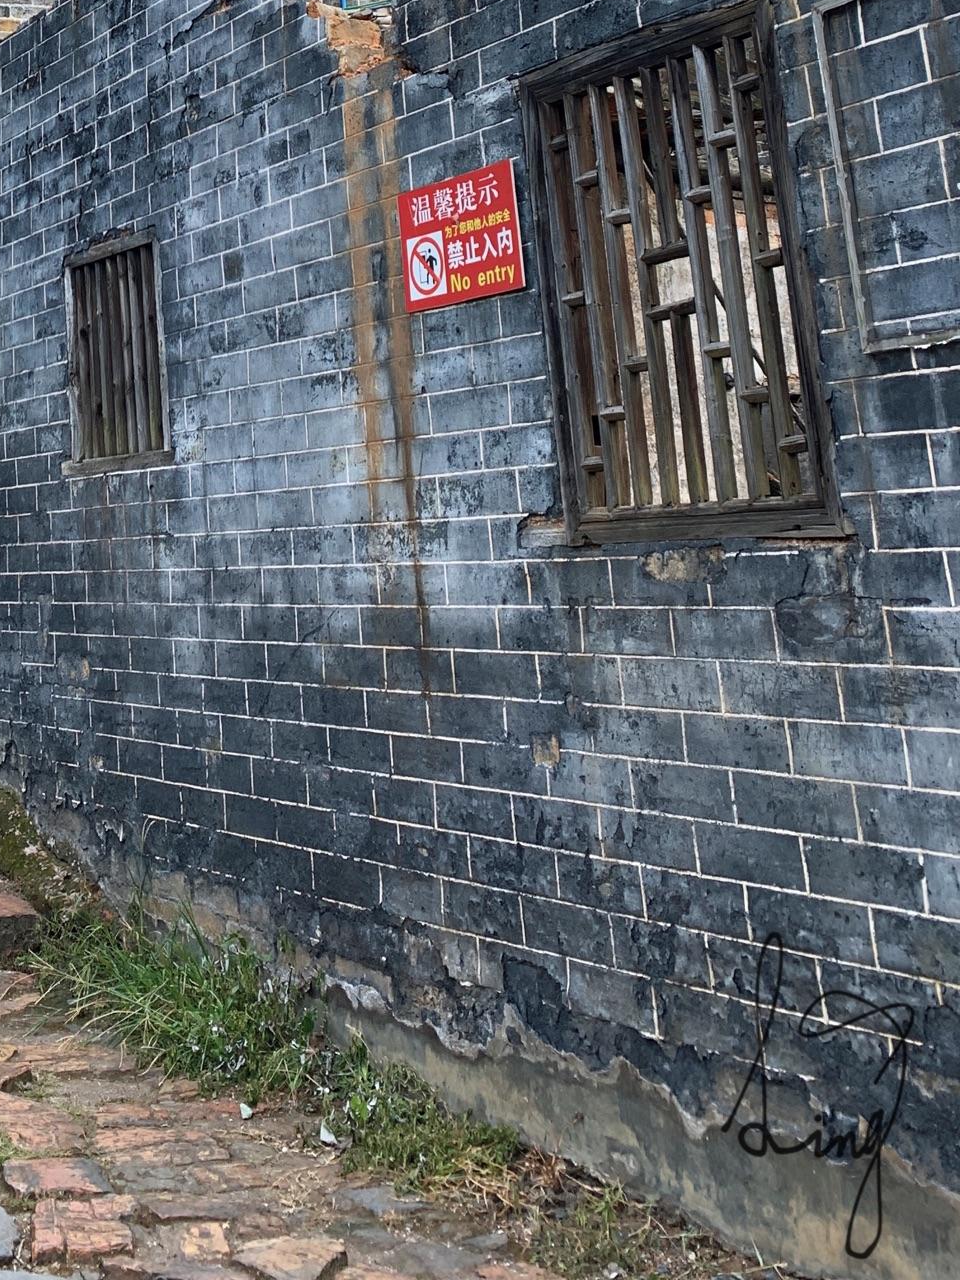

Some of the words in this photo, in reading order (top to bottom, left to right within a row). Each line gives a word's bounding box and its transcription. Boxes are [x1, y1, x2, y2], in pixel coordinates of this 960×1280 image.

[411, 173, 498, 226] 温馨提示
[445, 208, 511, 239] 为了您和他人的安全
[447, 227, 513, 269] 禁止入内
[450, 273, 471, 293] No
[479, 264, 515, 286] entry
